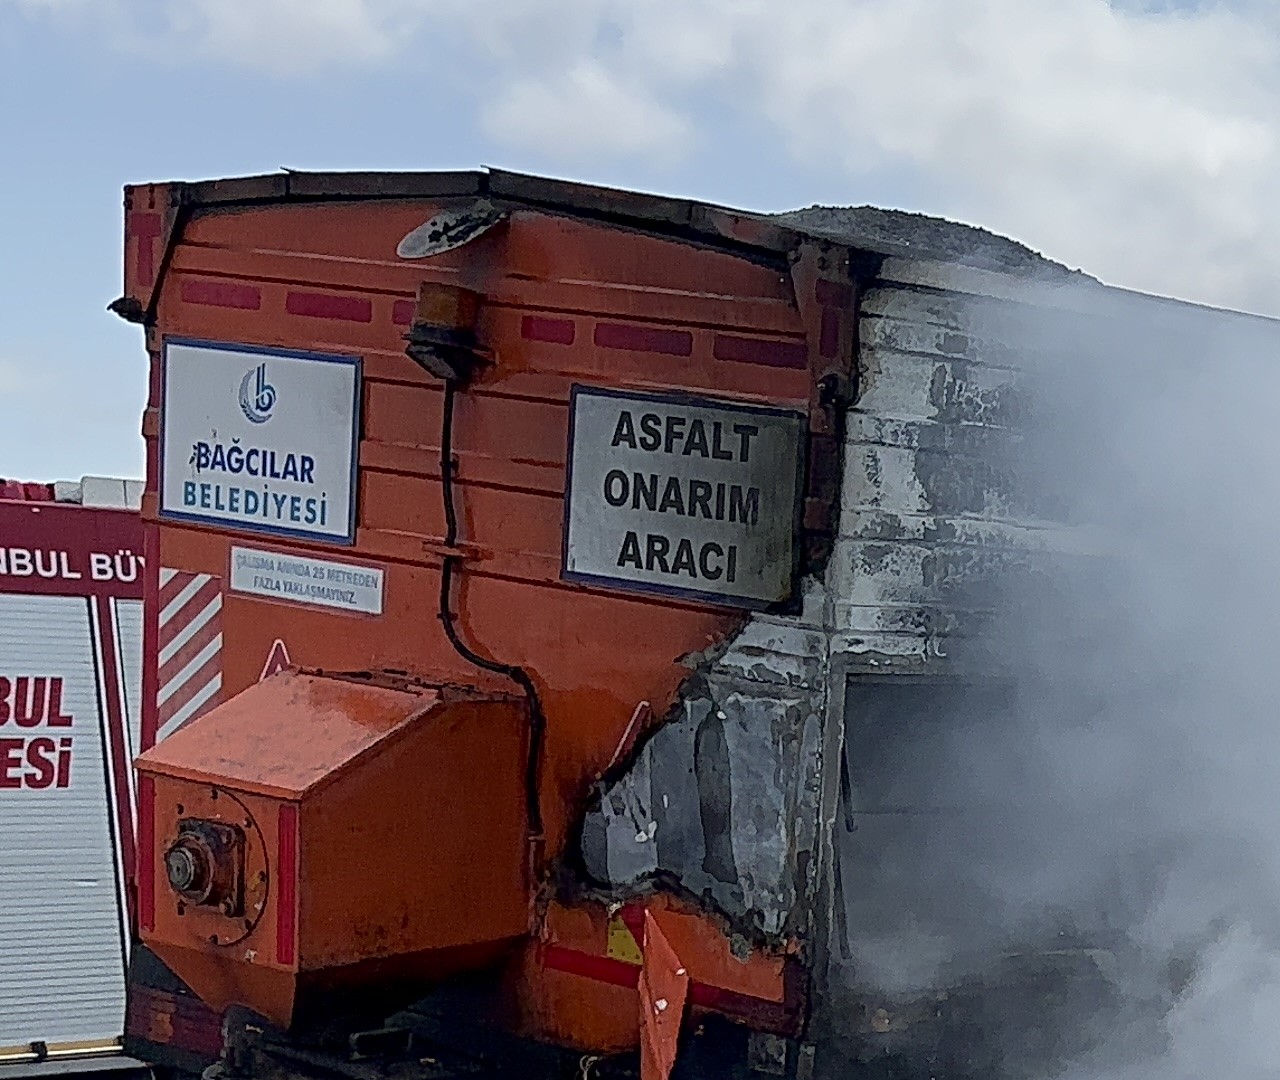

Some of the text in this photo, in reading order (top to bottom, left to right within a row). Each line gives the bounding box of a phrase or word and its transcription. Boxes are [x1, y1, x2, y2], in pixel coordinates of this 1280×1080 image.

[611, 411, 758, 462] ASFALT
[196, 437, 314, 483] BAĞCILAR
[184, 481, 327, 526] BELEDİYESİ
[604, 470, 759, 526] ONARIM
[313, 566, 325, 580] 25
[327, 569, 379, 589] METREDEN
[617, 531, 737, 583] ARACI
[253, 575, 281, 591] FAZLA
